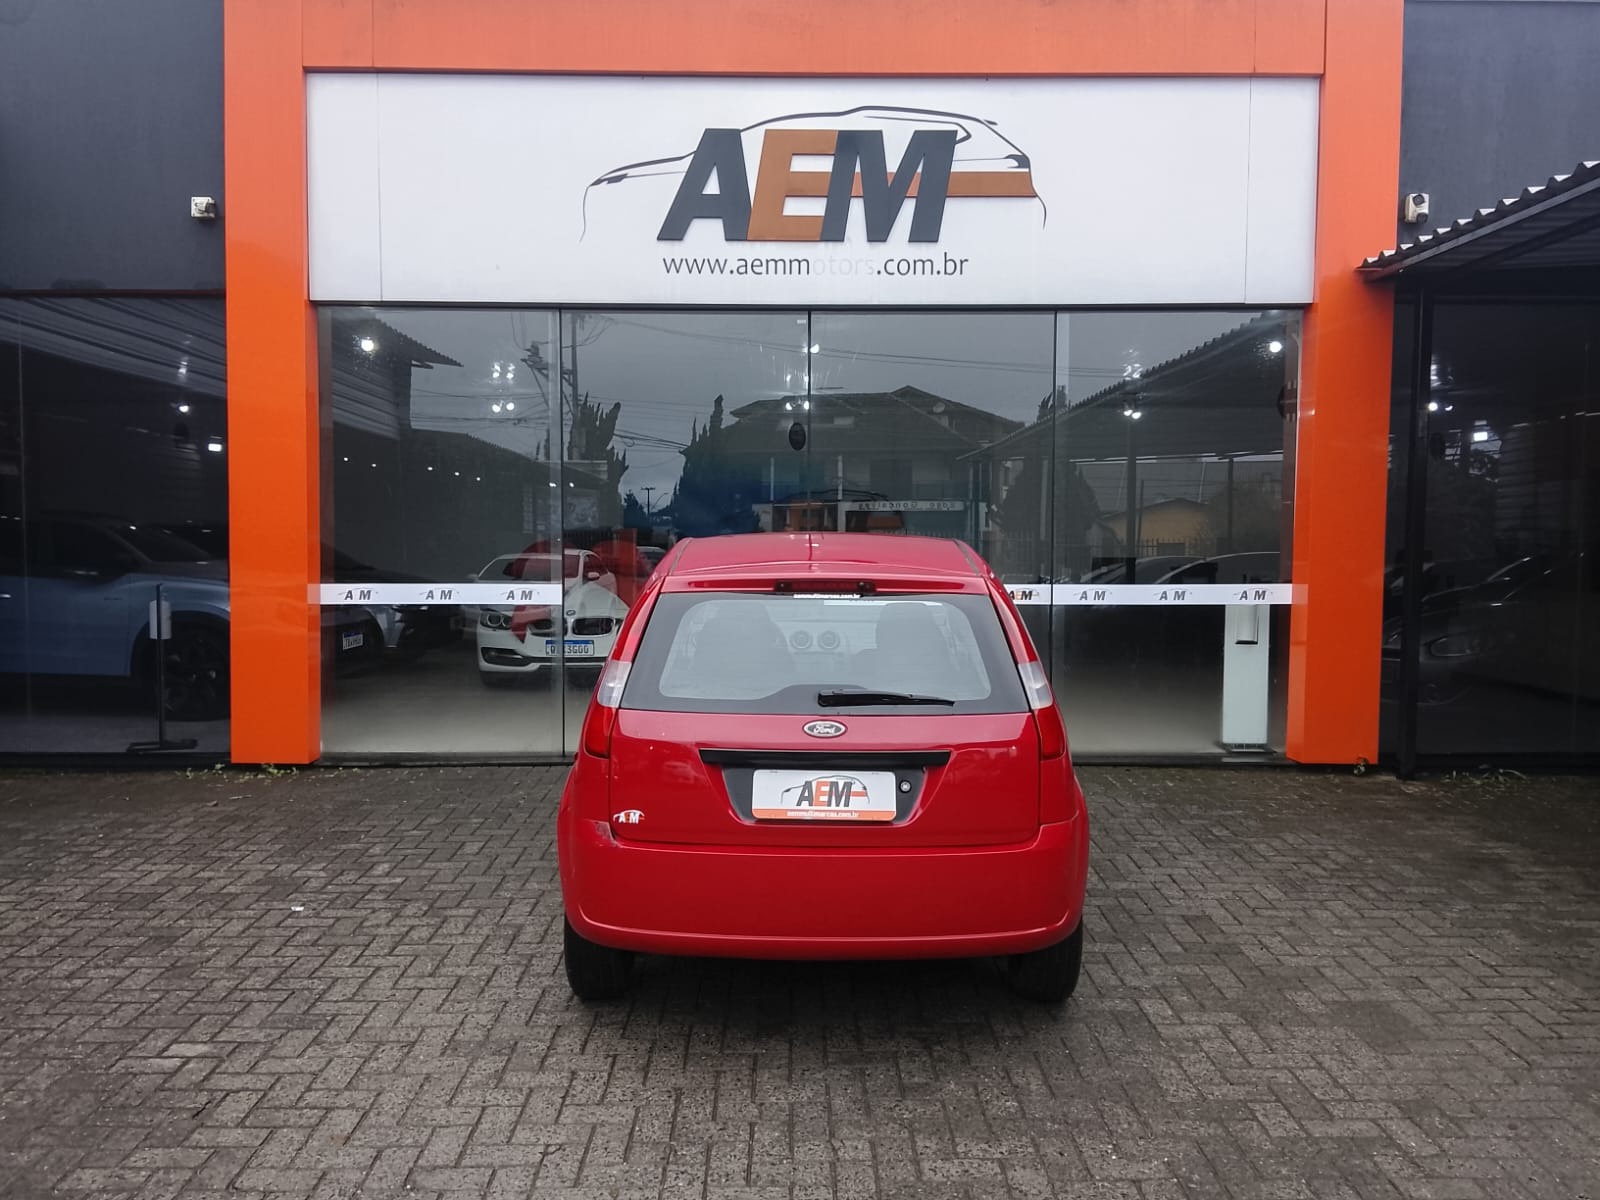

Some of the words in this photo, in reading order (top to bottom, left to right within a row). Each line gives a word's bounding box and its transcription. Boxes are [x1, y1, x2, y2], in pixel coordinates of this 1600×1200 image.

[657, 128, 958, 243] AEM
[813, 723, 837, 735] Ford
[796, 780, 853, 808] AEM
